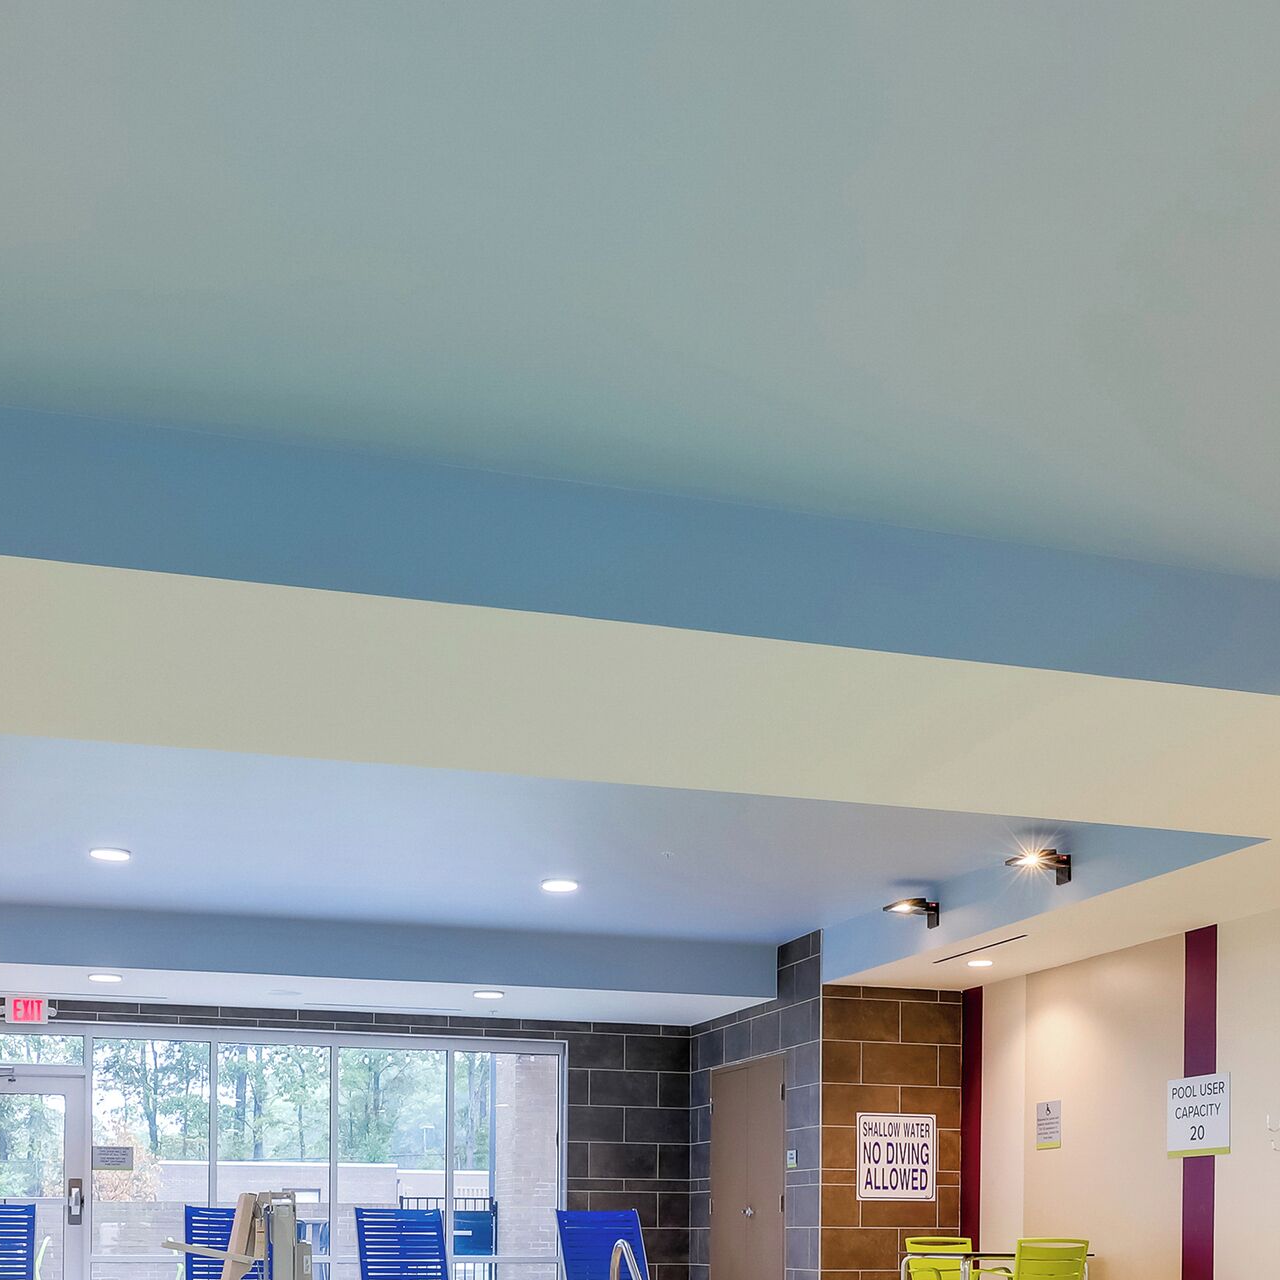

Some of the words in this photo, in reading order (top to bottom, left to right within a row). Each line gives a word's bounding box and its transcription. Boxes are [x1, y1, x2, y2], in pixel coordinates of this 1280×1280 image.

[13, 999, 43, 1022] EXIT
[1172, 1085, 1197, 1100] POOL
[1200, 1081, 1225, 1096] USER
[1175, 1102, 1221, 1120] CAPACITY
[863, 1121, 900, 1137] SHALLOW
[903, 1123, 930, 1138] WATER
[1190, 1125, 1205, 1141] 20
[863, 1141, 881, 1165] NO
[886, 1142, 929, 1165] DIVING
[864, 1167, 928, 1191] ALLOWED
